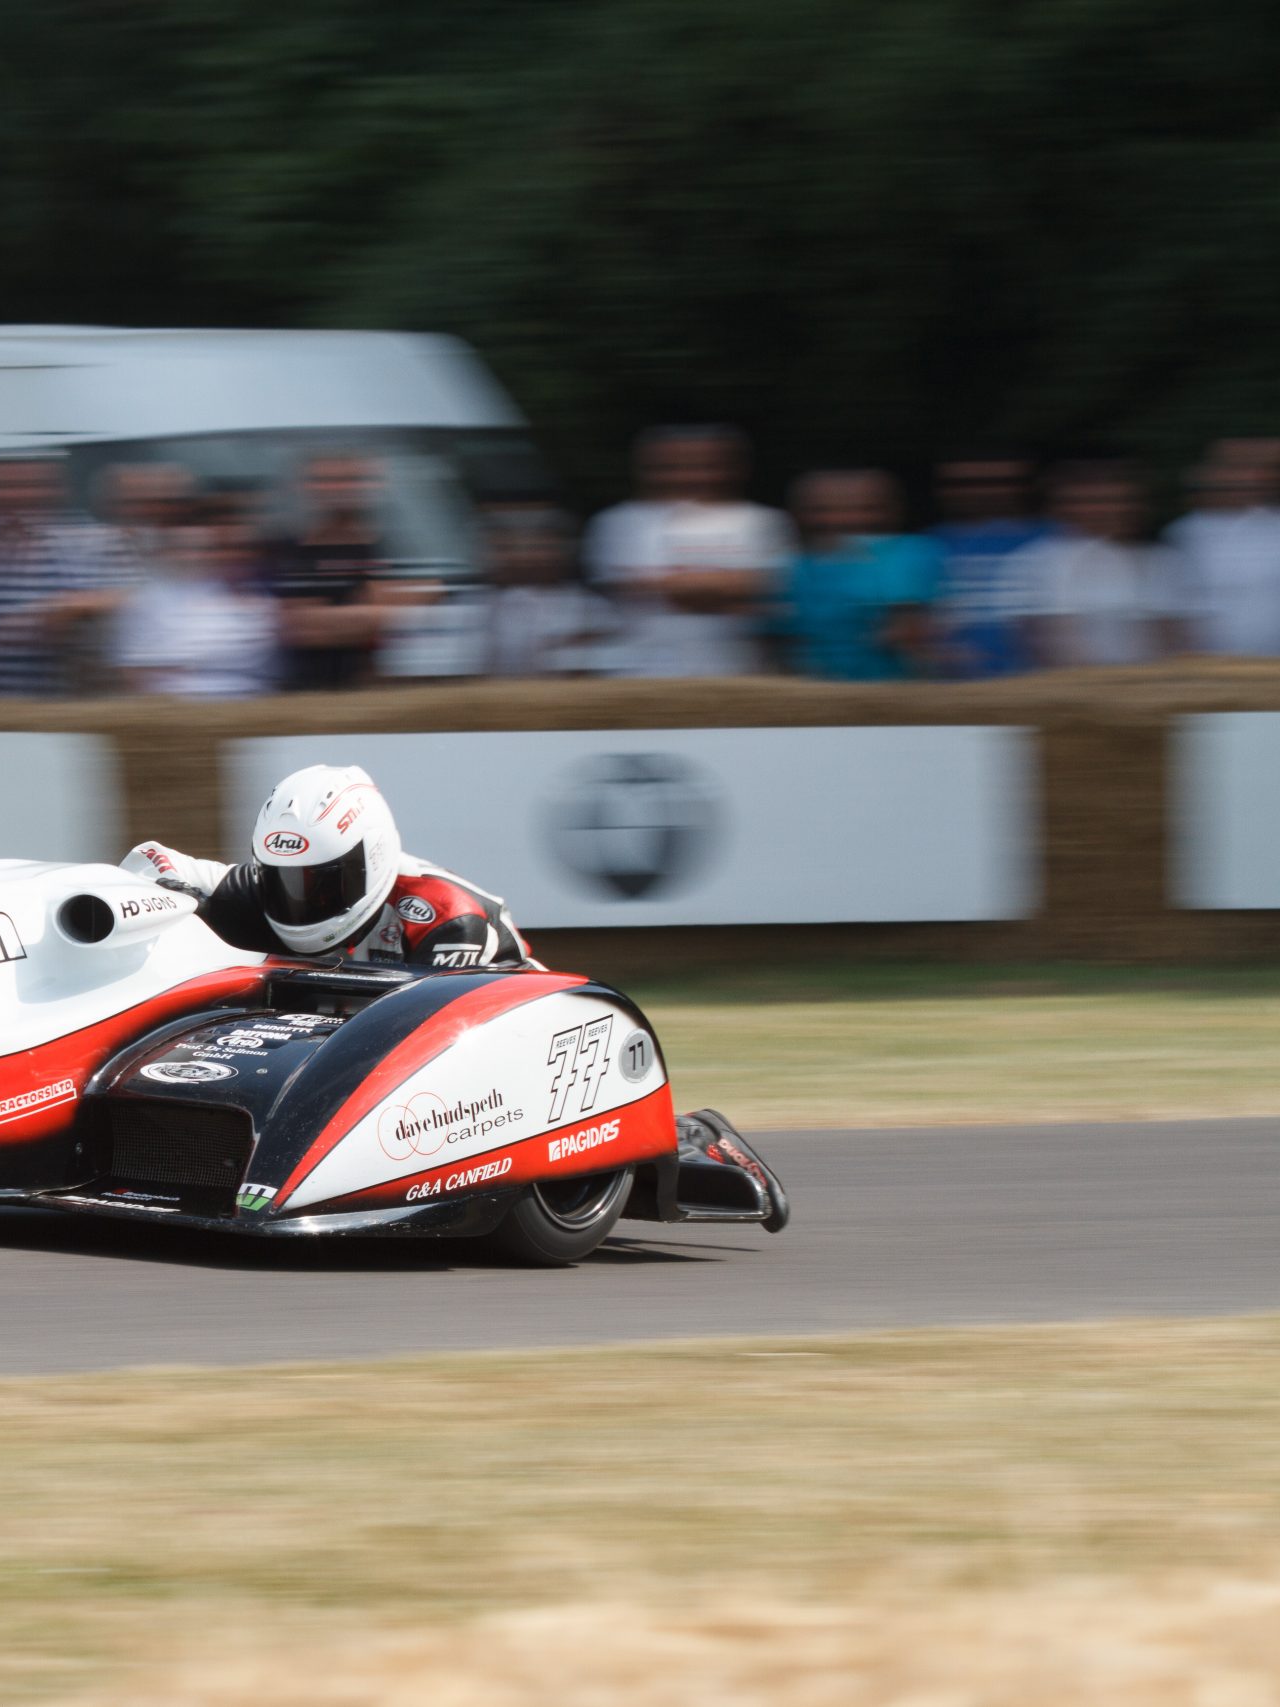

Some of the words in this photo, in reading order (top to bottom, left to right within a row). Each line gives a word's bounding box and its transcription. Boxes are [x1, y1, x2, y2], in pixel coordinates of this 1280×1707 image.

[266, 834, 303, 849] Arai
[120, 900, 140, 918] HD
[141, 896, 177, 913] SIGNS
[399, 898, 431, 917] Arai
[588, 1024, 608, 1037] REEVES
[556, 1035, 576, 1048] REEVES
[192, 1050, 235, 1060] GmbH
[547, 1014, 614, 1124] 77
[53, 1079, 74, 1097] LTD
[446, 1108, 524, 1144] carpets
[405, 1178, 441, 1201] G&A
[445, 1157, 513, 1191] CANFIELD
